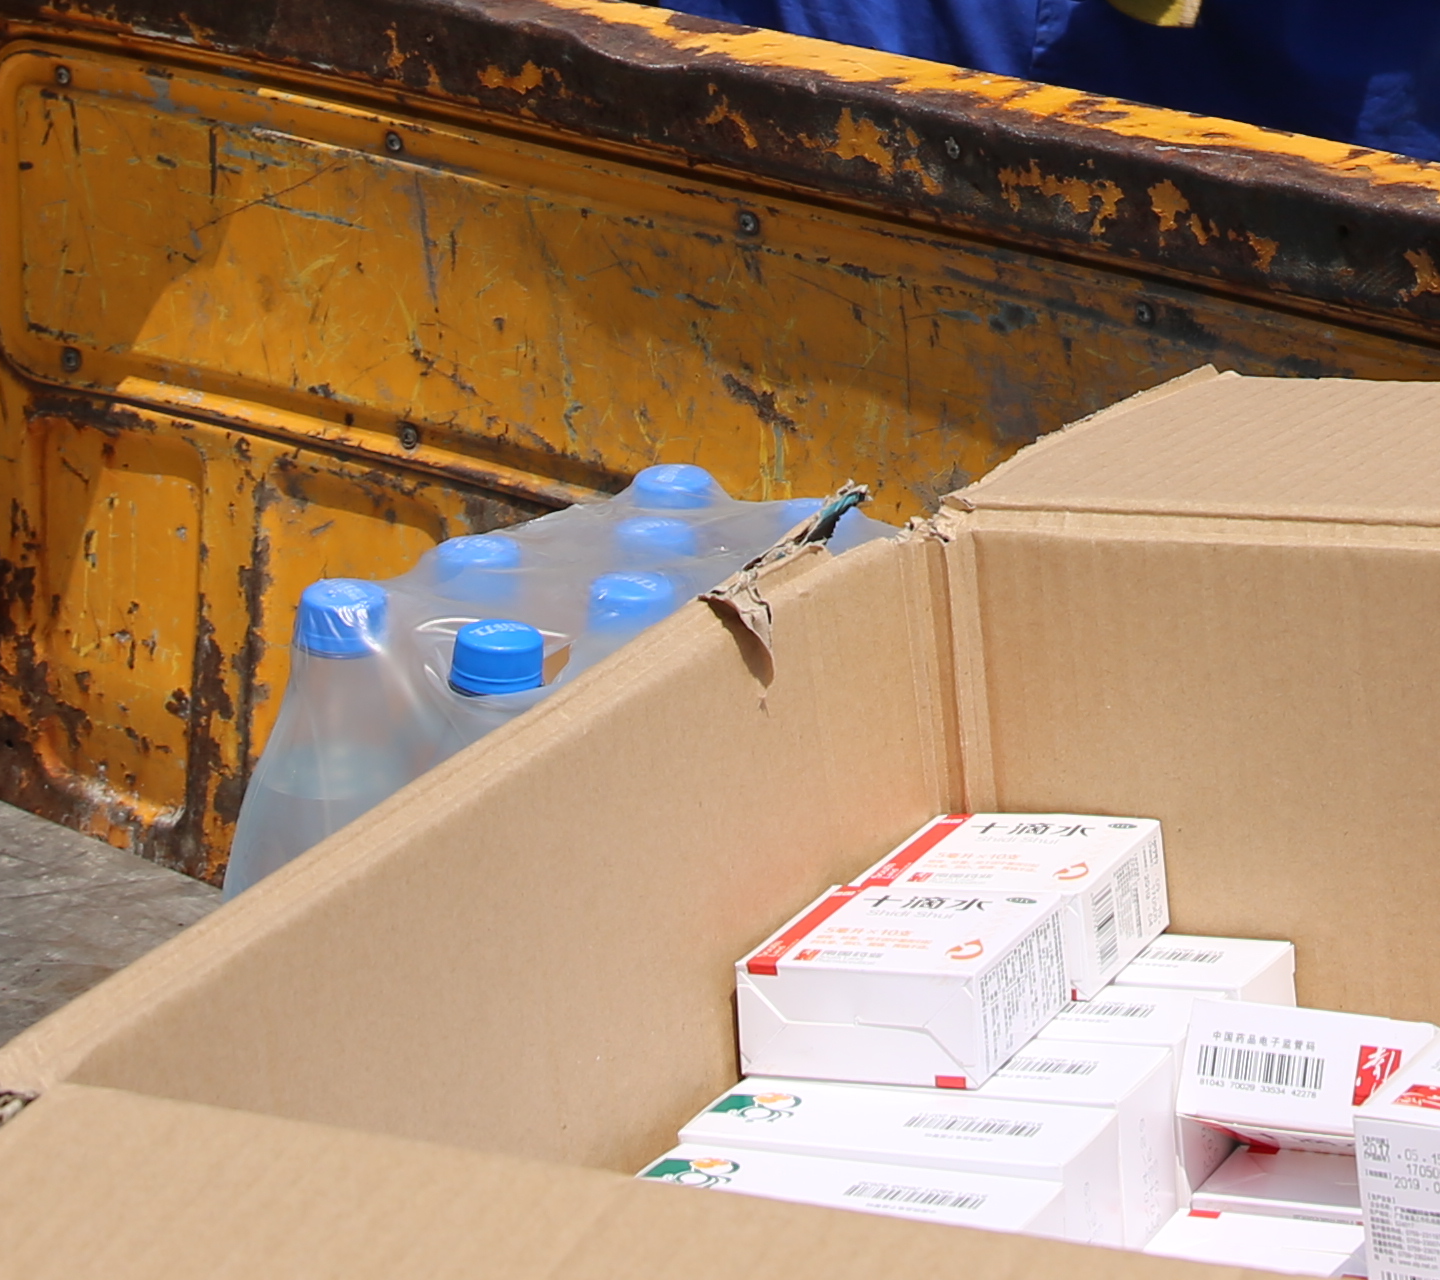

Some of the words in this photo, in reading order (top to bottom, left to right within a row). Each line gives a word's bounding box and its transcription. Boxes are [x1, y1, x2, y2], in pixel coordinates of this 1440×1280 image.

[972, 821, 1095, 838] 十滴水
[864, 894, 994, 911] 十滴水
[1212, 1030, 1316, 1053] 中国药品电子监管码
[1199, 1077, 1225, 1089] 81043
[1230, 1080, 1256, 1092] 70029
[1260, 1085, 1286, 1096] 33534
[1291, 1088, 1317, 1100] 42278
